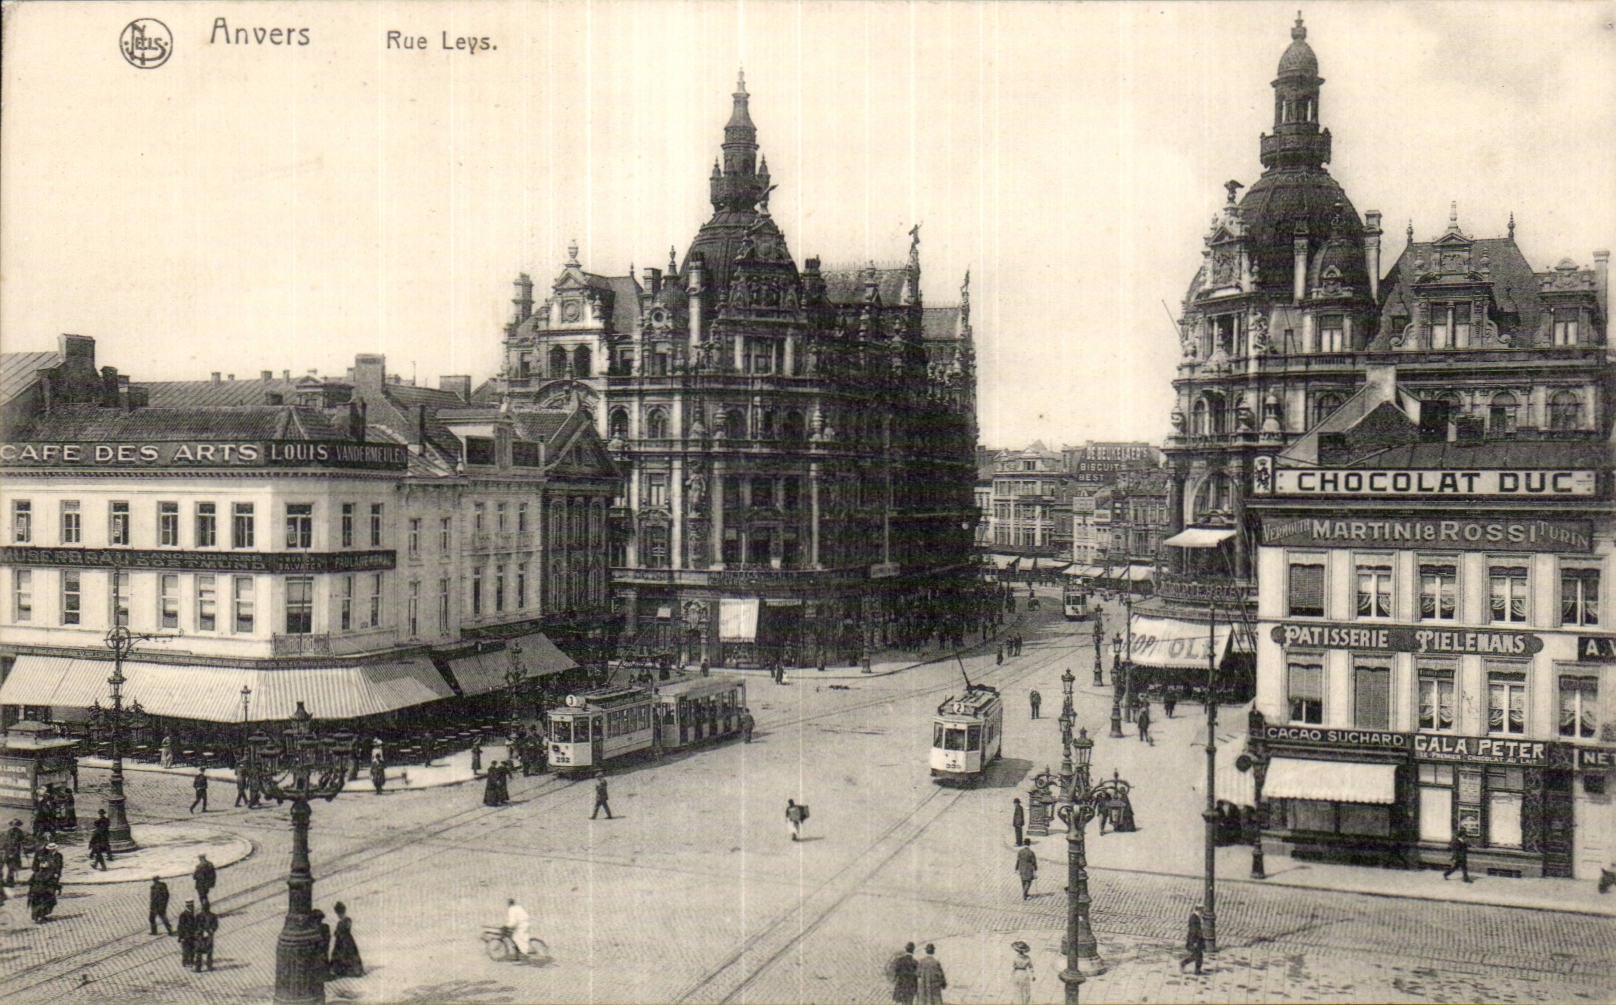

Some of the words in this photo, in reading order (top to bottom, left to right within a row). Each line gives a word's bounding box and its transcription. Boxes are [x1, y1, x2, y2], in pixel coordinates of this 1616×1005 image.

[0, 444, 81, 461] CAFE
[95, 444, 159, 462] DES
[172, 444, 258, 461] ARTS
[271, 443, 329, 461] LOUIS
[1298, 472, 1480, 492] CHOCOLAT
[1498, 472, 1572, 493] DUC
[1263, 519, 1310, 542] VERMOUTH
[1537, 520, 1589, 548] TURIN
[1283, 625, 1389, 648] PATISSERIE
[1415, 630, 1525, 653] PIELEMANS
[1267, 727, 1322, 742] CACAO
[1327, 730, 1404, 746] SUCHARD
[1415, 734, 1468, 755] GALA
[1477, 739, 1545, 759] PETER
[1584, 751, 1616, 765] NE
